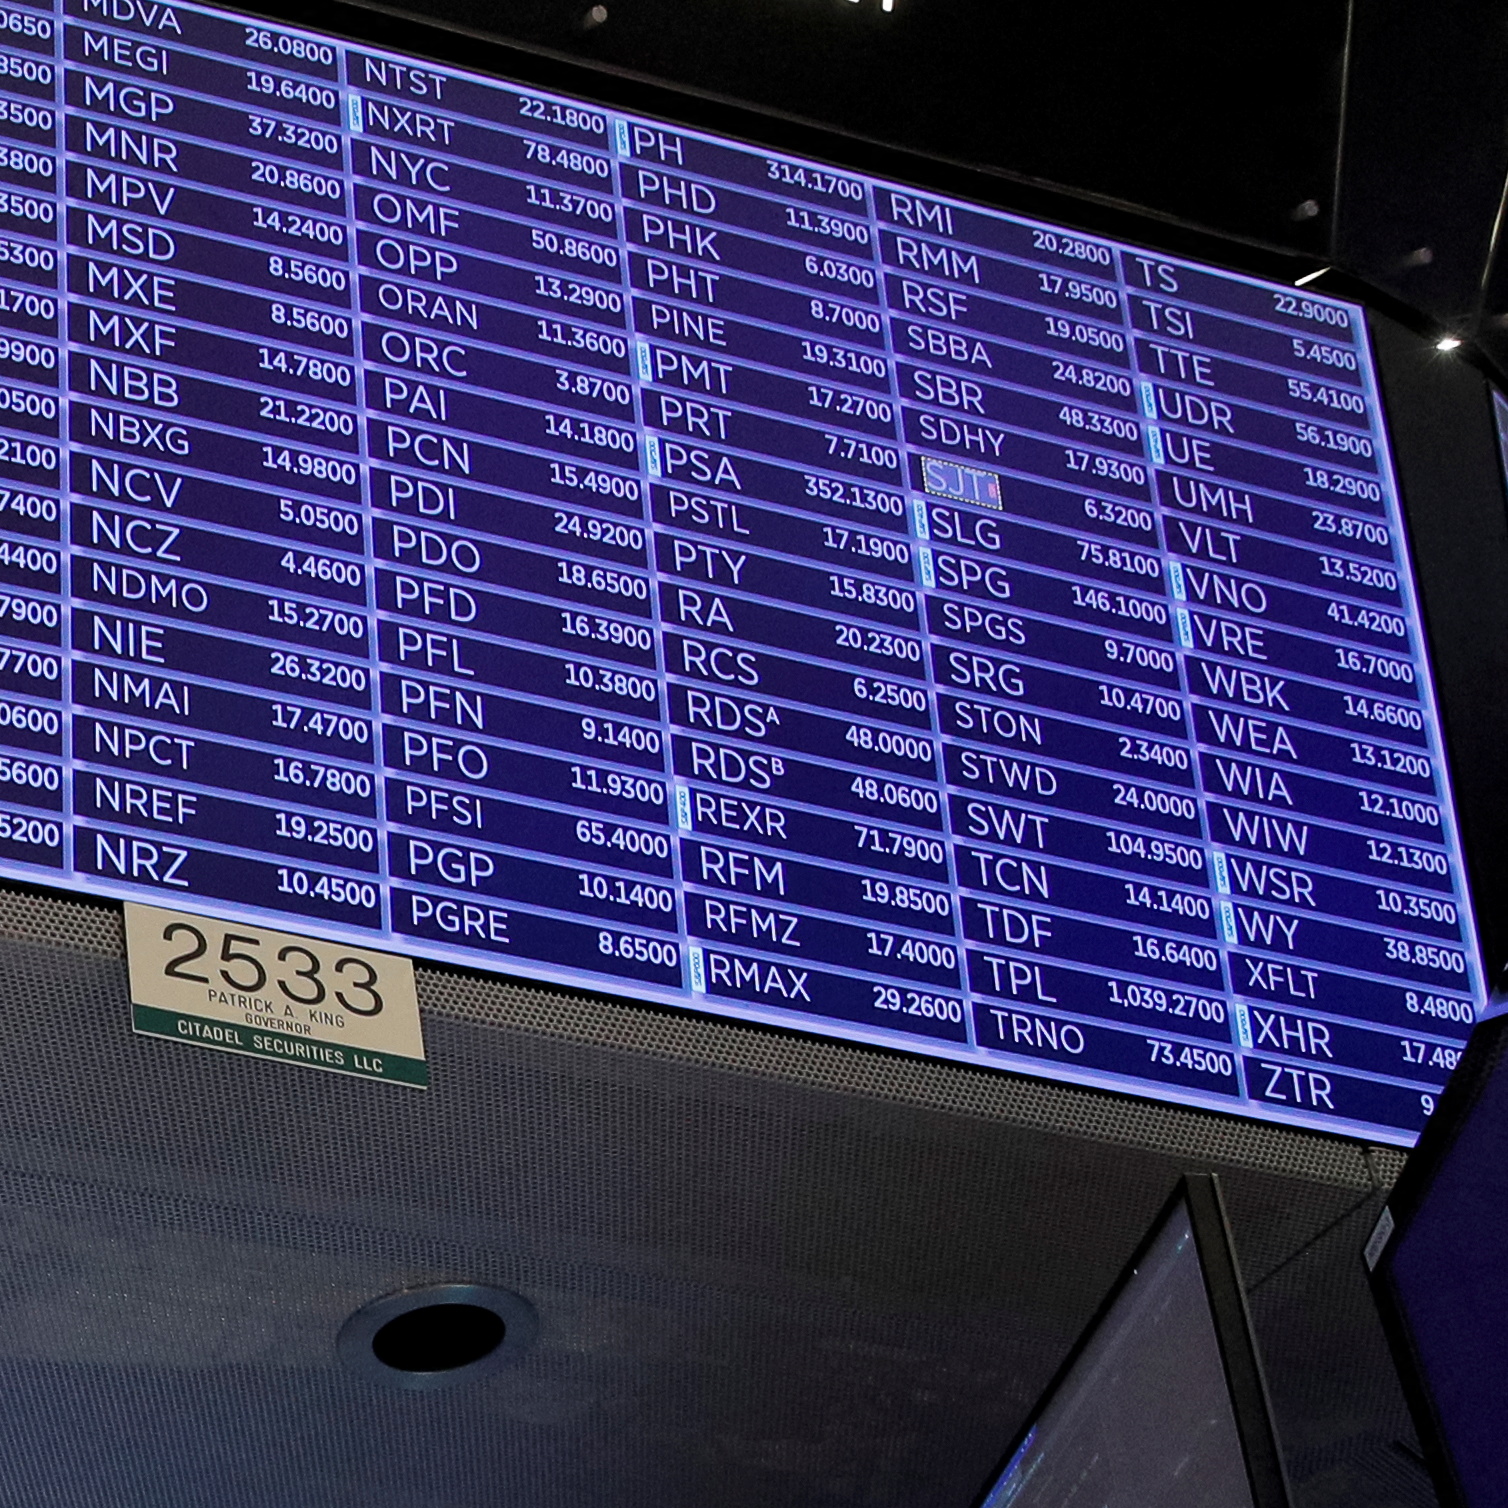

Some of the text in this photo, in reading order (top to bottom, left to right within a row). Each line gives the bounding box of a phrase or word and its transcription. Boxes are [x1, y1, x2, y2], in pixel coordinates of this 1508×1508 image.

[84, 74, 338, 154] MGP 37.3200
[364, 62, 605, 134] NTST 22.1800
[632, 125, 863, 201] PH 314.1700
[86, 212, 346, 291] MSD 8.5600
[889, 191, 1110, 266] RMI 20.2800
[1134, 256, 1348, 328] TS 22.9000
[380, 330, 630, 405] ORC 3.8700
[650, 303, 886, 378] PINE 19.3100
[89, 357, 354, 436] NBB 21.2200
[912, 369, 1138, 441] SBR 48.3300
[389, 473, 643, 550] PDI 24.9200
[664, 441, 903, 517] PSA 352.1300
[1171, 475, 1389, 546] UMH 23.8700
[92, 561, 364, 639] NDMO 15.2700
[936, 554, 1167, 625] SPG 146.1000
[681, 638, 926, 712] RCS 6.2500
[1199, 660, 1422, 731] WBK 14.6600
[94, 720, 371, 798] NPCT 16.7800
[960, 750, 1196, 820] STWD 24.0000
[405, 784, 668, 858] PFSI 65.4000
[1221, 806, 1448, 875] WIW 12.1300
[95, 832, 376, 908] NRZ 10.4500
[160, 921, 385, 1018] 2533
[1236, 906, 1465, 974] WY 38.8500
[207, 988, 274, 1014] PATRICK
[308, 1008, 345, 1028] KING
[244, 1012, 312, 1036] GOVERNOR
[708, 952, 962, 1023] RMAX 29.2600
[176, 1018, 384, 1073] CITADEL SECURITIES LLC
[988, 1008, 1232, 1076] TRNO 73.4500
